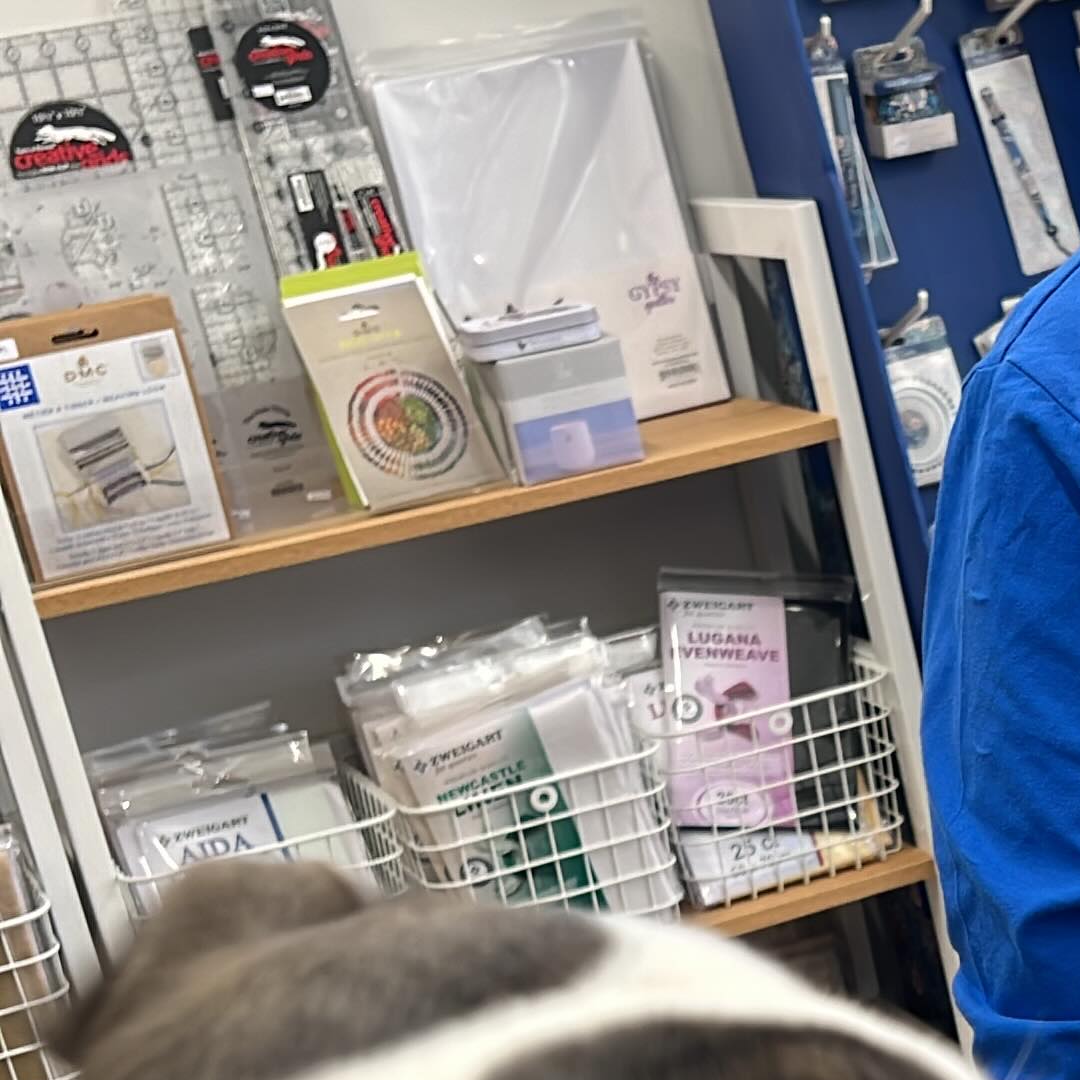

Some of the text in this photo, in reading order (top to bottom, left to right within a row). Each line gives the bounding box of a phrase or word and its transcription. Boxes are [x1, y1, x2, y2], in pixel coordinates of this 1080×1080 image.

[687, 632, 761, 646] LUGANA
[430, 730, 502, 766] ZWEIGART
[437, 760, 525, 803] NEWCASTLE
[181, 833, 254, 865] AIDA
